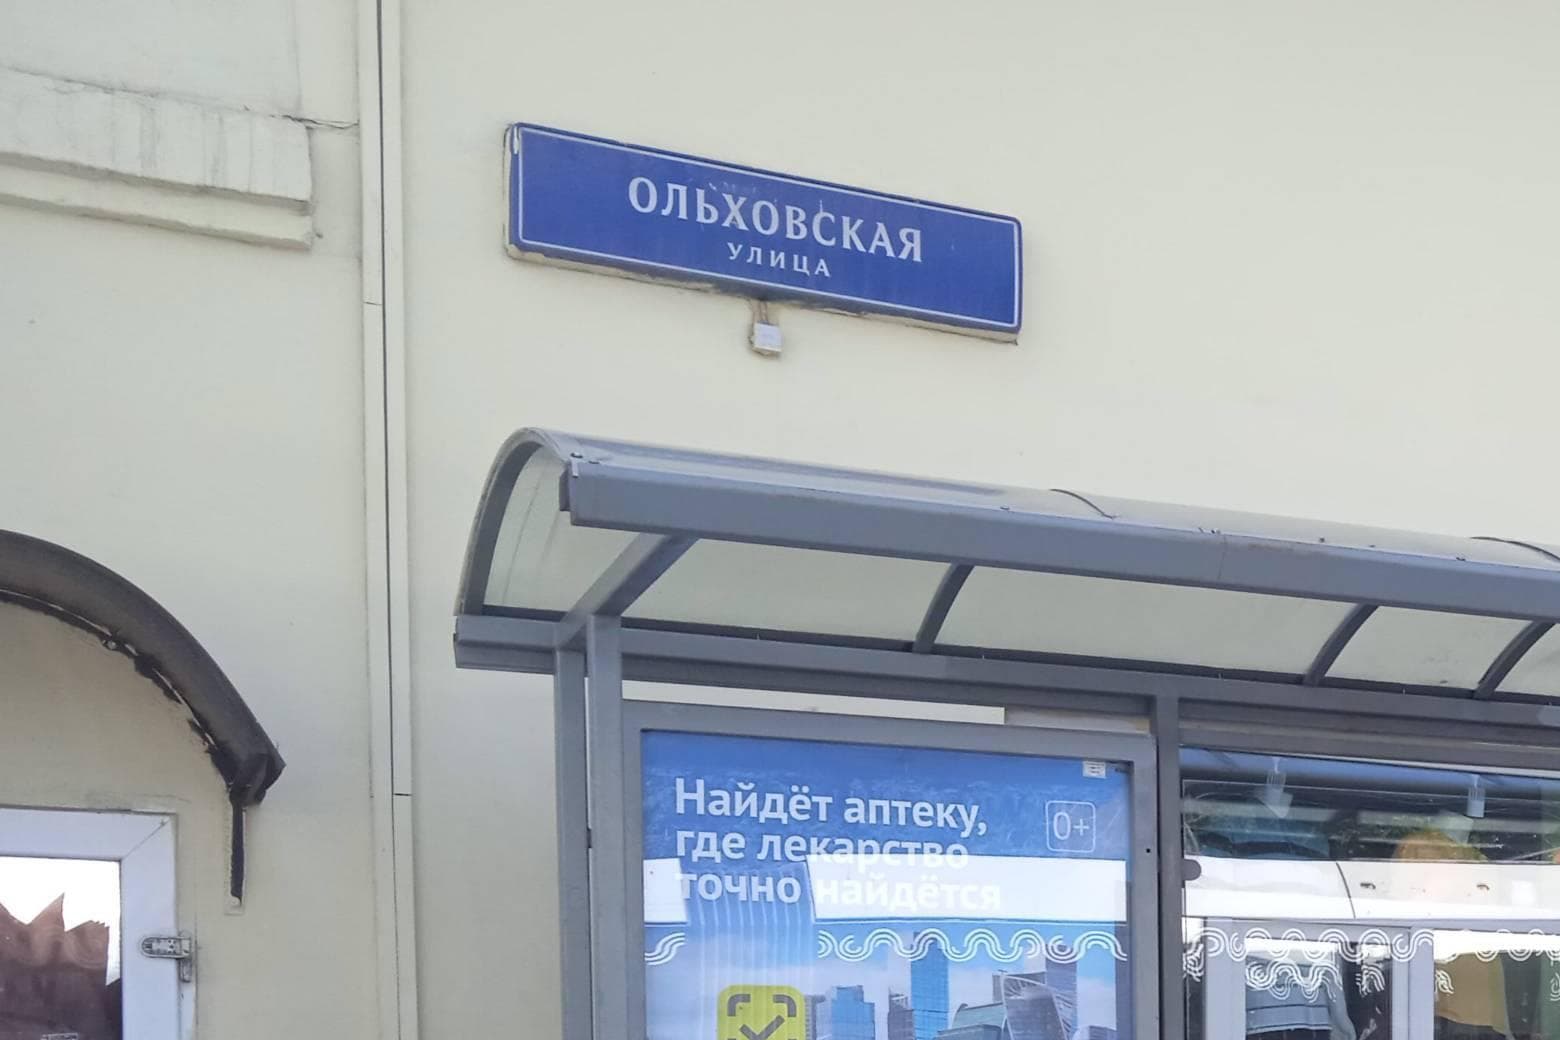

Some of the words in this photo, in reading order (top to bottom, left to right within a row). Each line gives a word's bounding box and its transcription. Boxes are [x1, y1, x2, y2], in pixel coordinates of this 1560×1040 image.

[628, 176, 923, 262] ОЛЬХОВСКАЯ
[727, 241, 832, 278] УЛИЦА
[675, 778, 832, 824] Найдёт
[844, 795, 989, 838] аптеку,
[1053, 811, 1090, 840] 0+
[675, 827, 746, 863] где
[757, 830, 969, 873] лекарство
[675, 872, 802, 904] точно
[815, 872, 1001, 913] найдётся
